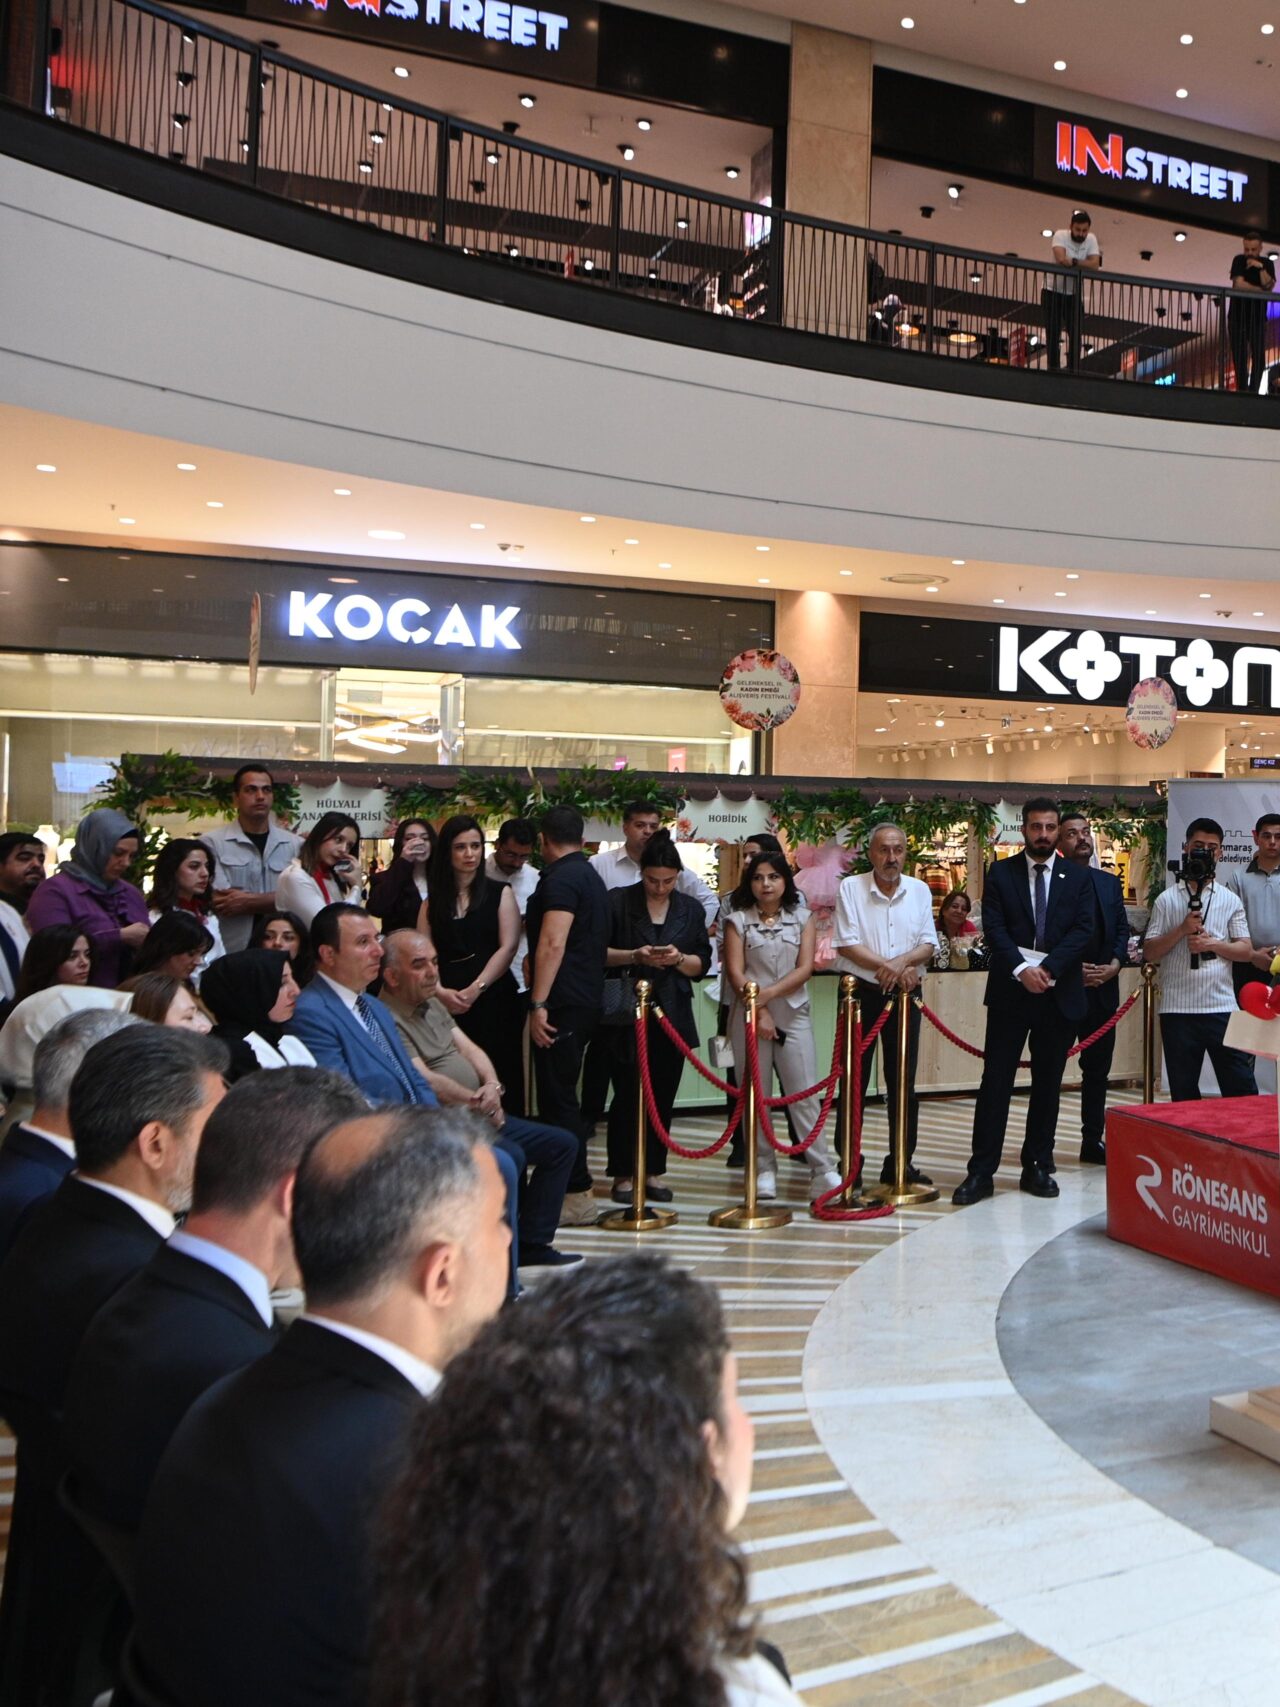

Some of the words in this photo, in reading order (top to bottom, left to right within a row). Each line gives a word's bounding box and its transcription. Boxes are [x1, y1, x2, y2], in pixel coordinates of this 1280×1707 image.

[316, 798, 361, 808] HÜLYALI
[708, 813, 747, 823] HOBİDİK
[1172, 1163, 1268, 1224] RÖNESANS
[1172, 1205, 1271, 1258] GAYRİMENKUL
